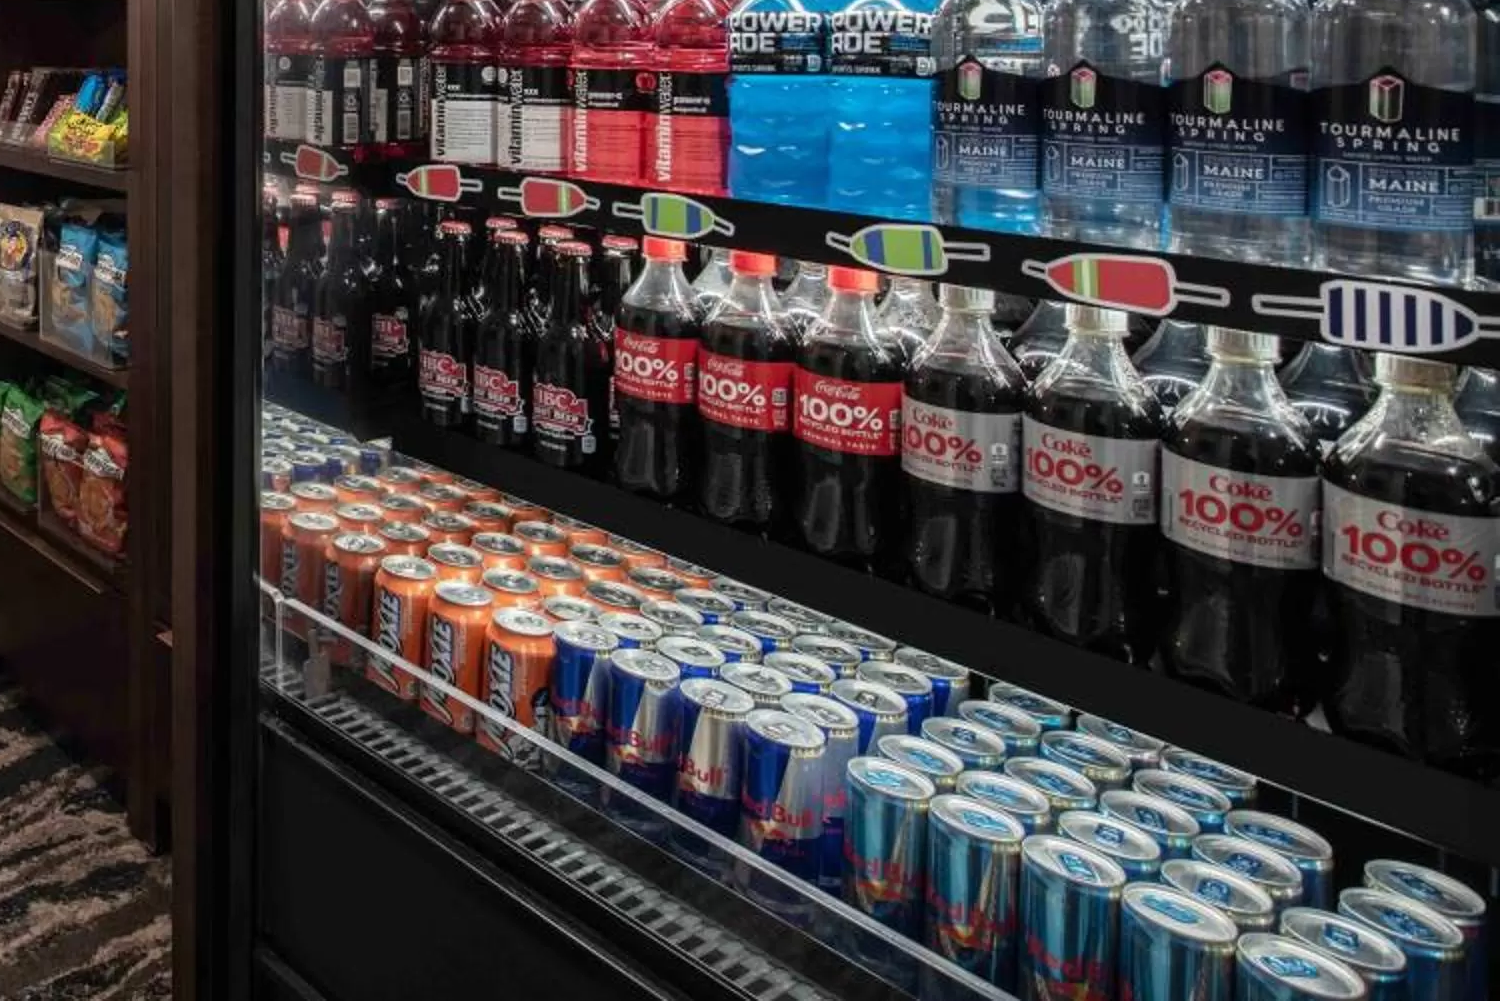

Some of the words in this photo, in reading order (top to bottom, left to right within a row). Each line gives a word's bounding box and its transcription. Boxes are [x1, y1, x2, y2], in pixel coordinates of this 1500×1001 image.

[729, 11, 824, 33] POWER
[831, 10, 933, 35] POWER
[729, 32, 776, 53] ADE
[831, 32, 883, 54] ADE
[1043, 108, 1147, 125] TOURMALINE
[1170, 113, 1285, 132] TOURMALINE
[1319, 121, 1461, 143] TOURMALINE
[1336, 136, 1441, 154] SPRING
[1071, 156, 1125, 170] MAINE
[1203, 164, 1265, 180] MAINE
[1368, 178, 1440, 194] MAINE
[800, 393, 884, 432] 100%
[912, 406, 955, 431] Coke
[1042, 432, 1093, 460] Coke
[1027, 446, 1124, 494] 100%
[1209, 473, 1273, 502] Coke
[1179, 488, 1304, 537] 100%
[1377, 509, 1450, 541] Coke
[1341, 524, 1487, 582] 100%
